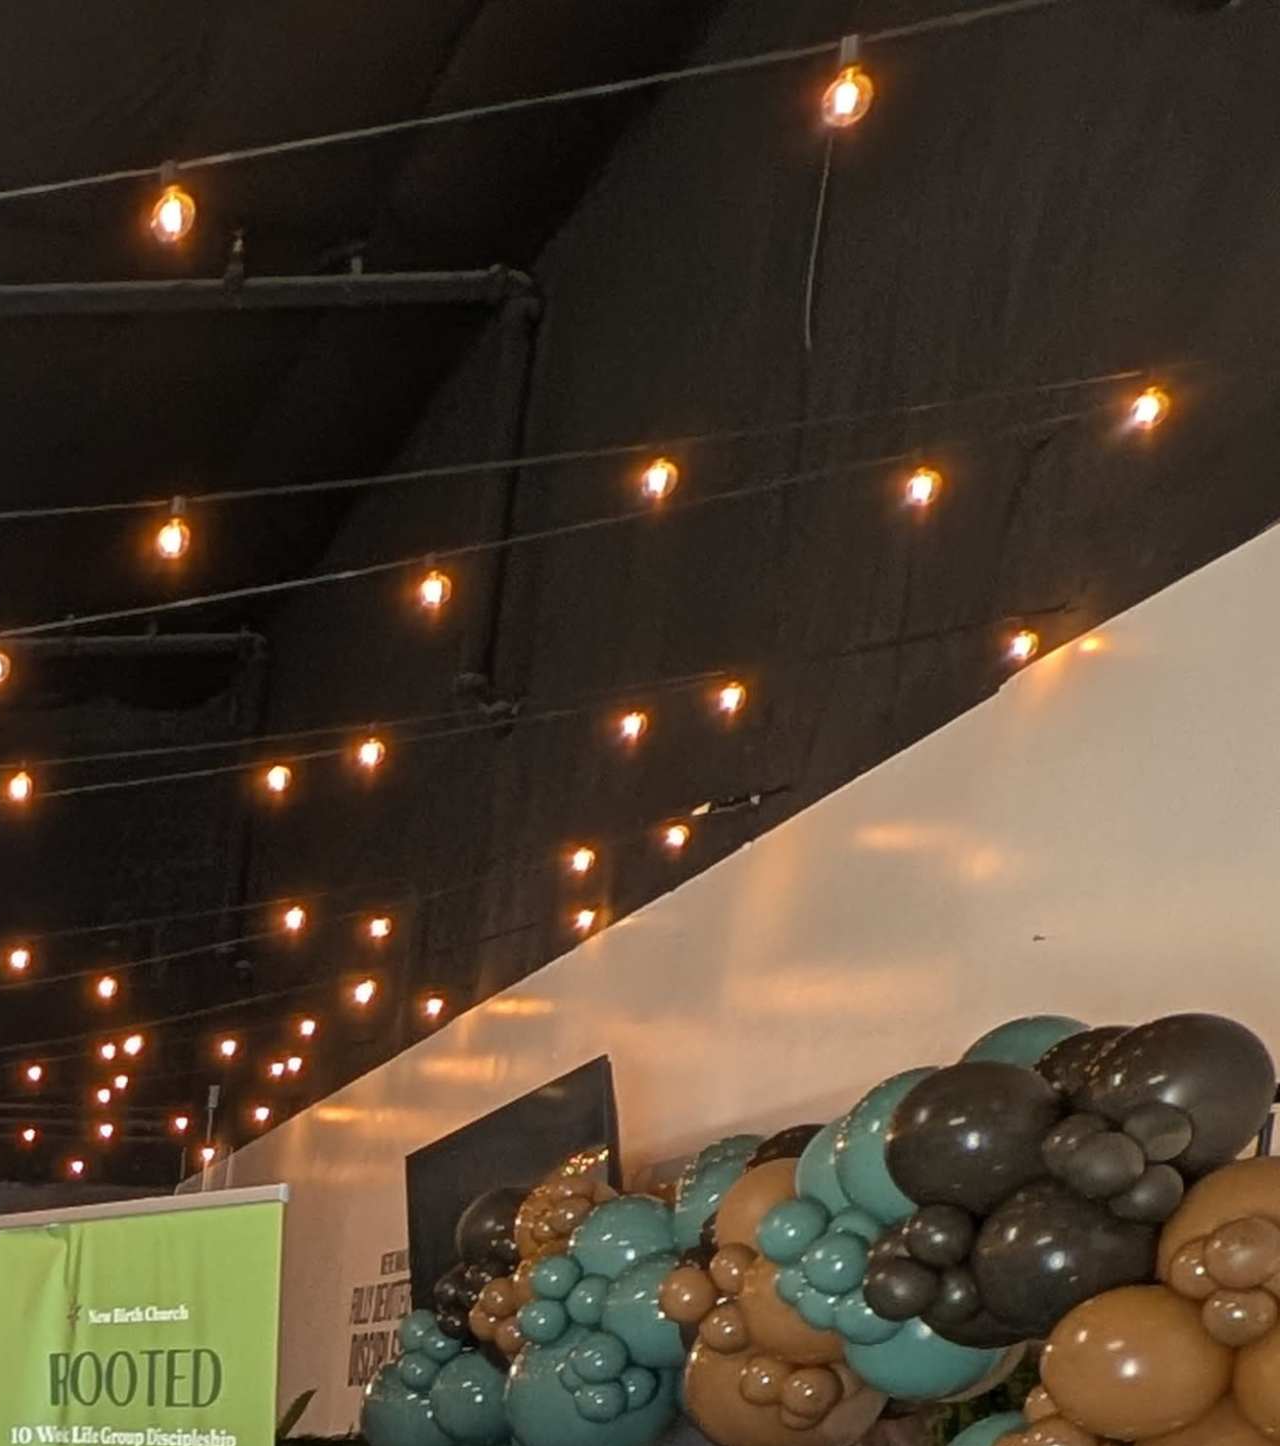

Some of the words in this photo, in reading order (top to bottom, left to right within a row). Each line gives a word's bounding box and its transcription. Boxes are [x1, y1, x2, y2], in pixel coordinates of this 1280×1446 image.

[145, 1303, 189, 1322] Church
[50, 1348, 222, 1408] ROOTED
[11, 1427, 33, 1444] 10
